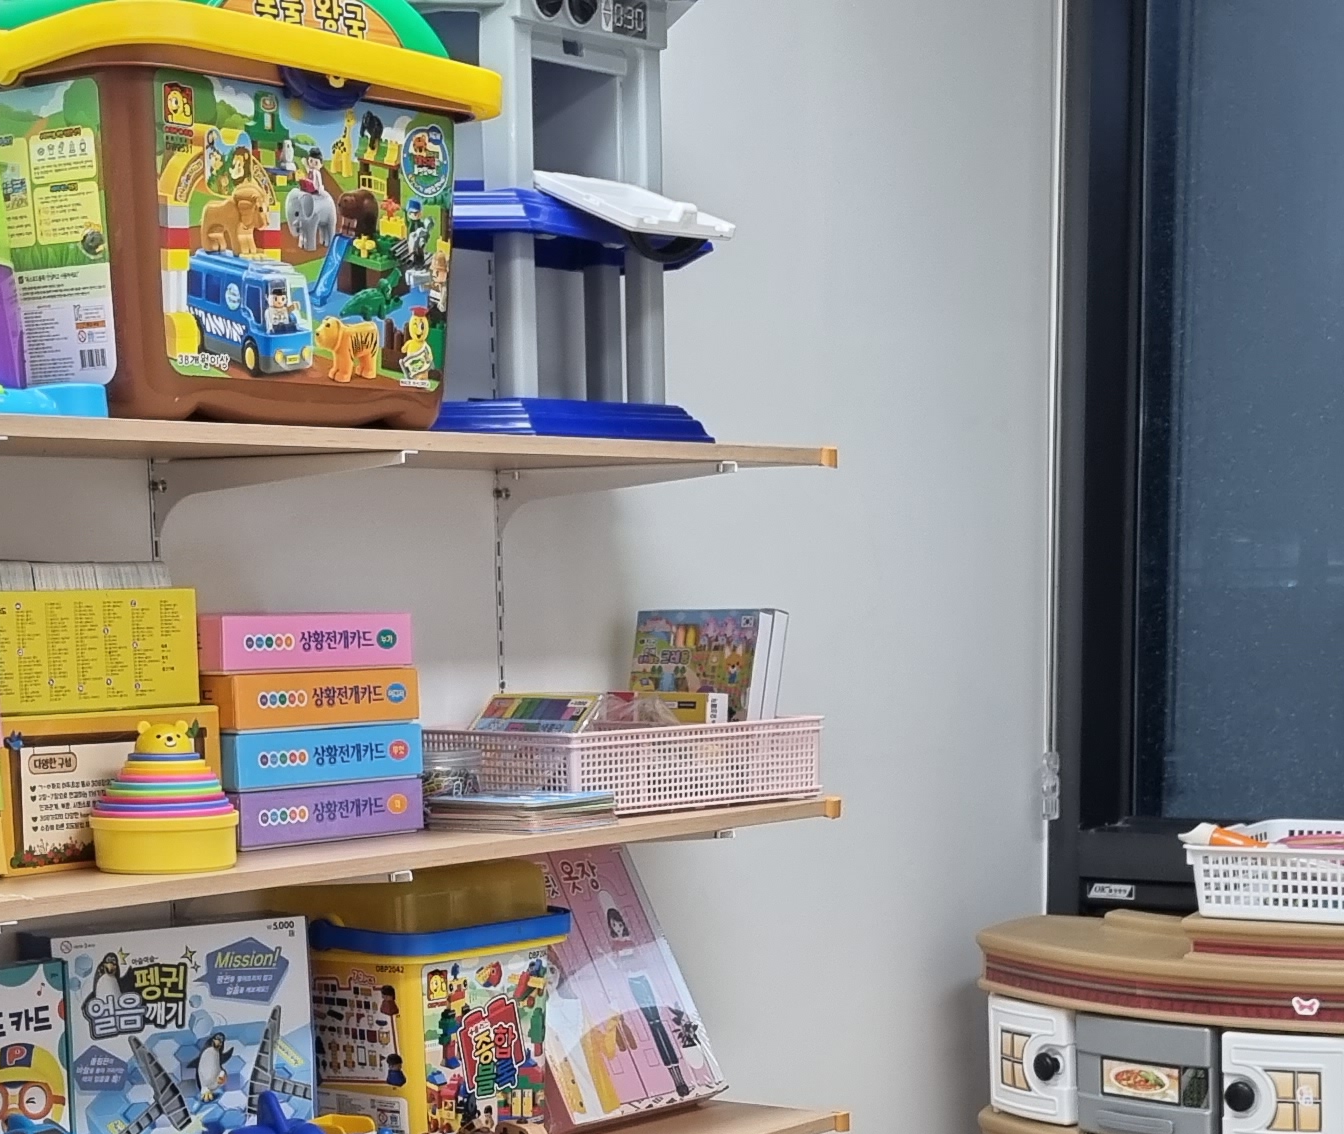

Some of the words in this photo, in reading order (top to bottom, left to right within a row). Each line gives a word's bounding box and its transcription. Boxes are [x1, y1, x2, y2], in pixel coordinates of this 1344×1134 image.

[299, 629, 375, 652] 상황전개카드
[311, 684, 385, 709] 상황전개카드
[312, 742, 386, 767] 상황전개카드
[312, 796, 386, 822] 상황전개카드
[560, 860, 601, 895] 옷장
[214, 946, 283, 969] Mission!
[133, 964, 186, 1001] 펭귄
[8, 1005, 53, 1033] 카드
[86, 992, 148, 1036] 얼음
[146, 1001, 185, 1029] 깨기
